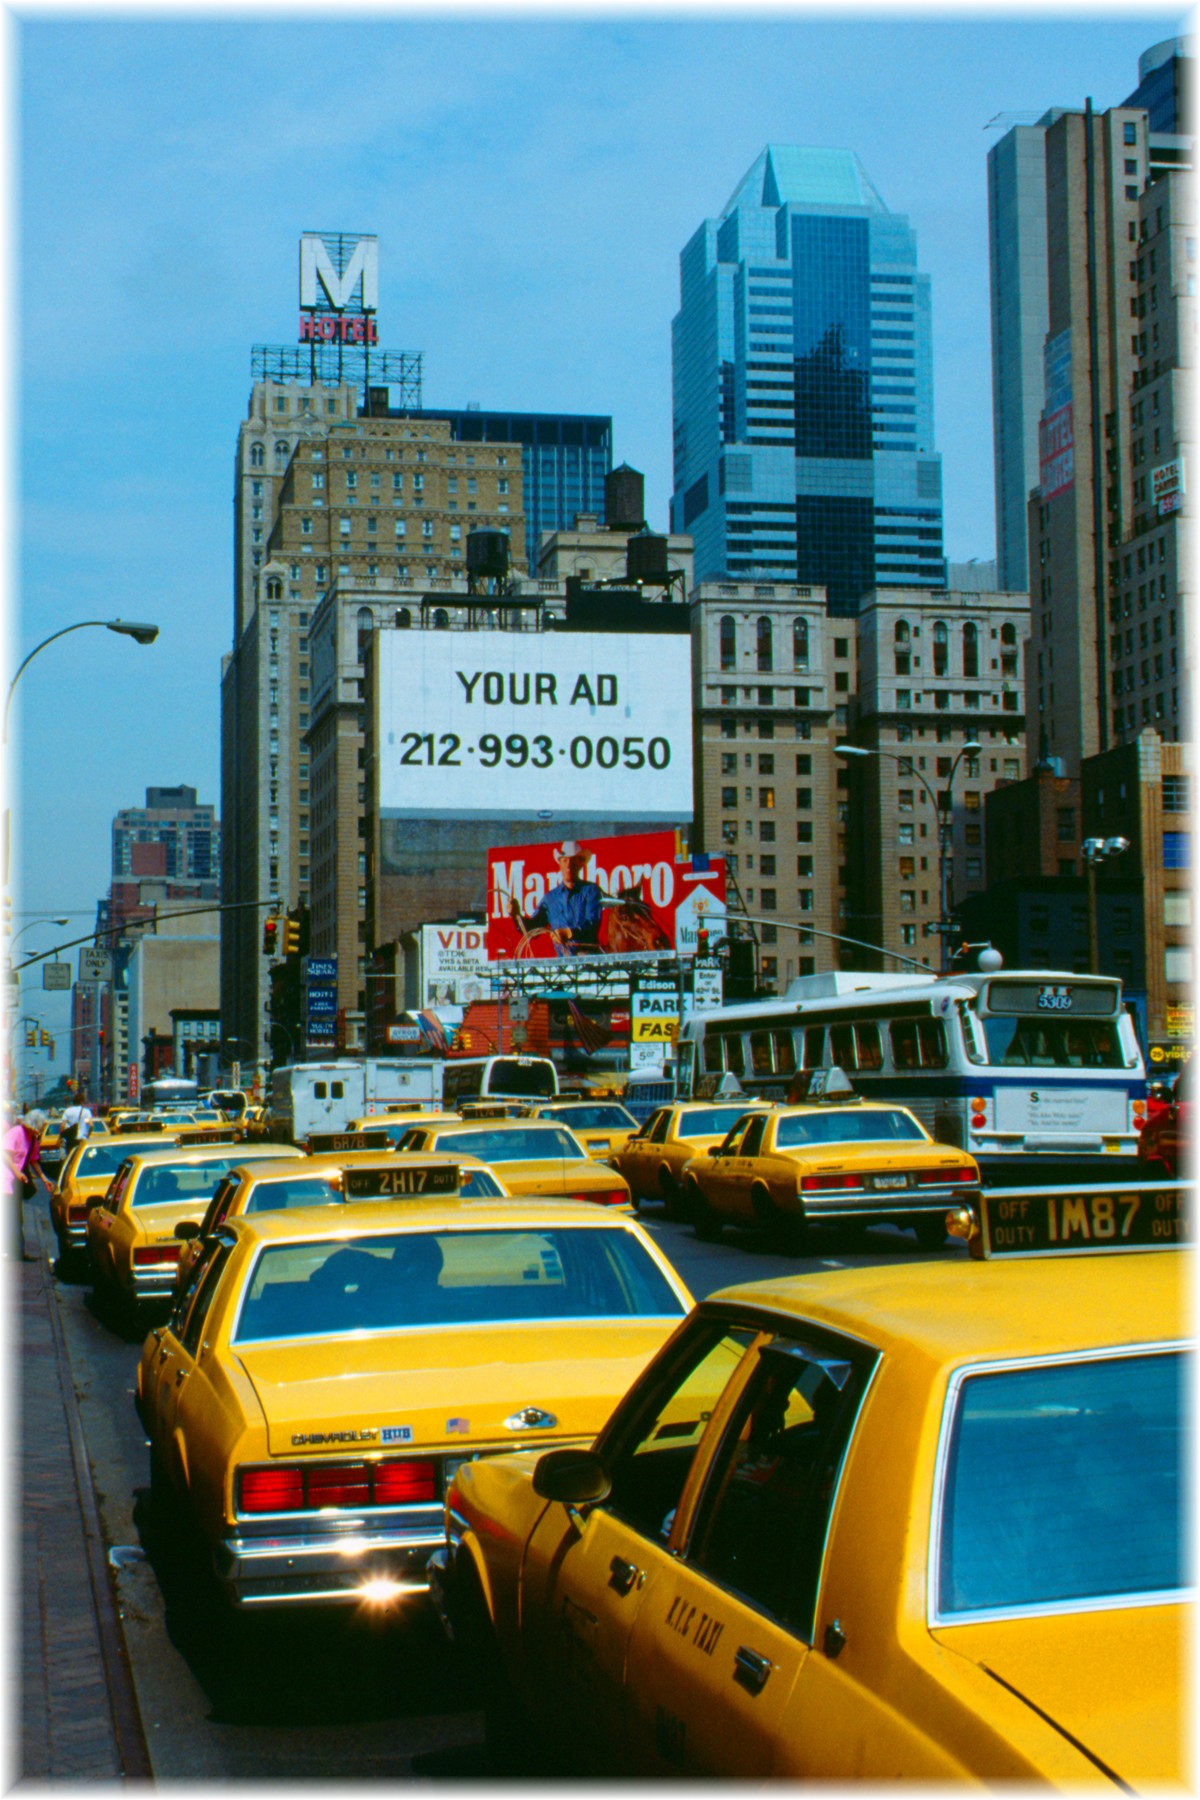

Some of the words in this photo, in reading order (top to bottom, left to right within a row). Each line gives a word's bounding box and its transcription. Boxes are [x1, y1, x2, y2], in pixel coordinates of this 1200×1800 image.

[300, 238, 378, 309] M
[299, 316, 379, 341] HOTEL
[1154, 463, 1178, 482] HOTEL
[455, 671, 557, 705] YOUR
[570, 674, 618, 706] AD
[85, 950, 109, 959] TAXIS
[440, 957, 456, 965] VHS
[696, 955, 721, 968] PARK
[85, 960, 107, 968] ONLY
[699, 971, 716, 979] Enter
[638, 979, 676, 990] Edison
[639, 998, 688, 1013] PARK
[1038, 994, 1072, 1009] 5309
[639, 1022, 680, 1037] FAS
[351, 1179, 371, 1189] OFF
[433, 1175, 455, 1184] DUTY
[999, 1201, 1030, 1219] OFF
[995, 1226, 1035, 1244] DUTY
[291, 1428, 379, 1446] CHEVROLET
[381, 1427, 412, 1441] HUB
[692, 1613, 725, 1657] TAXI
